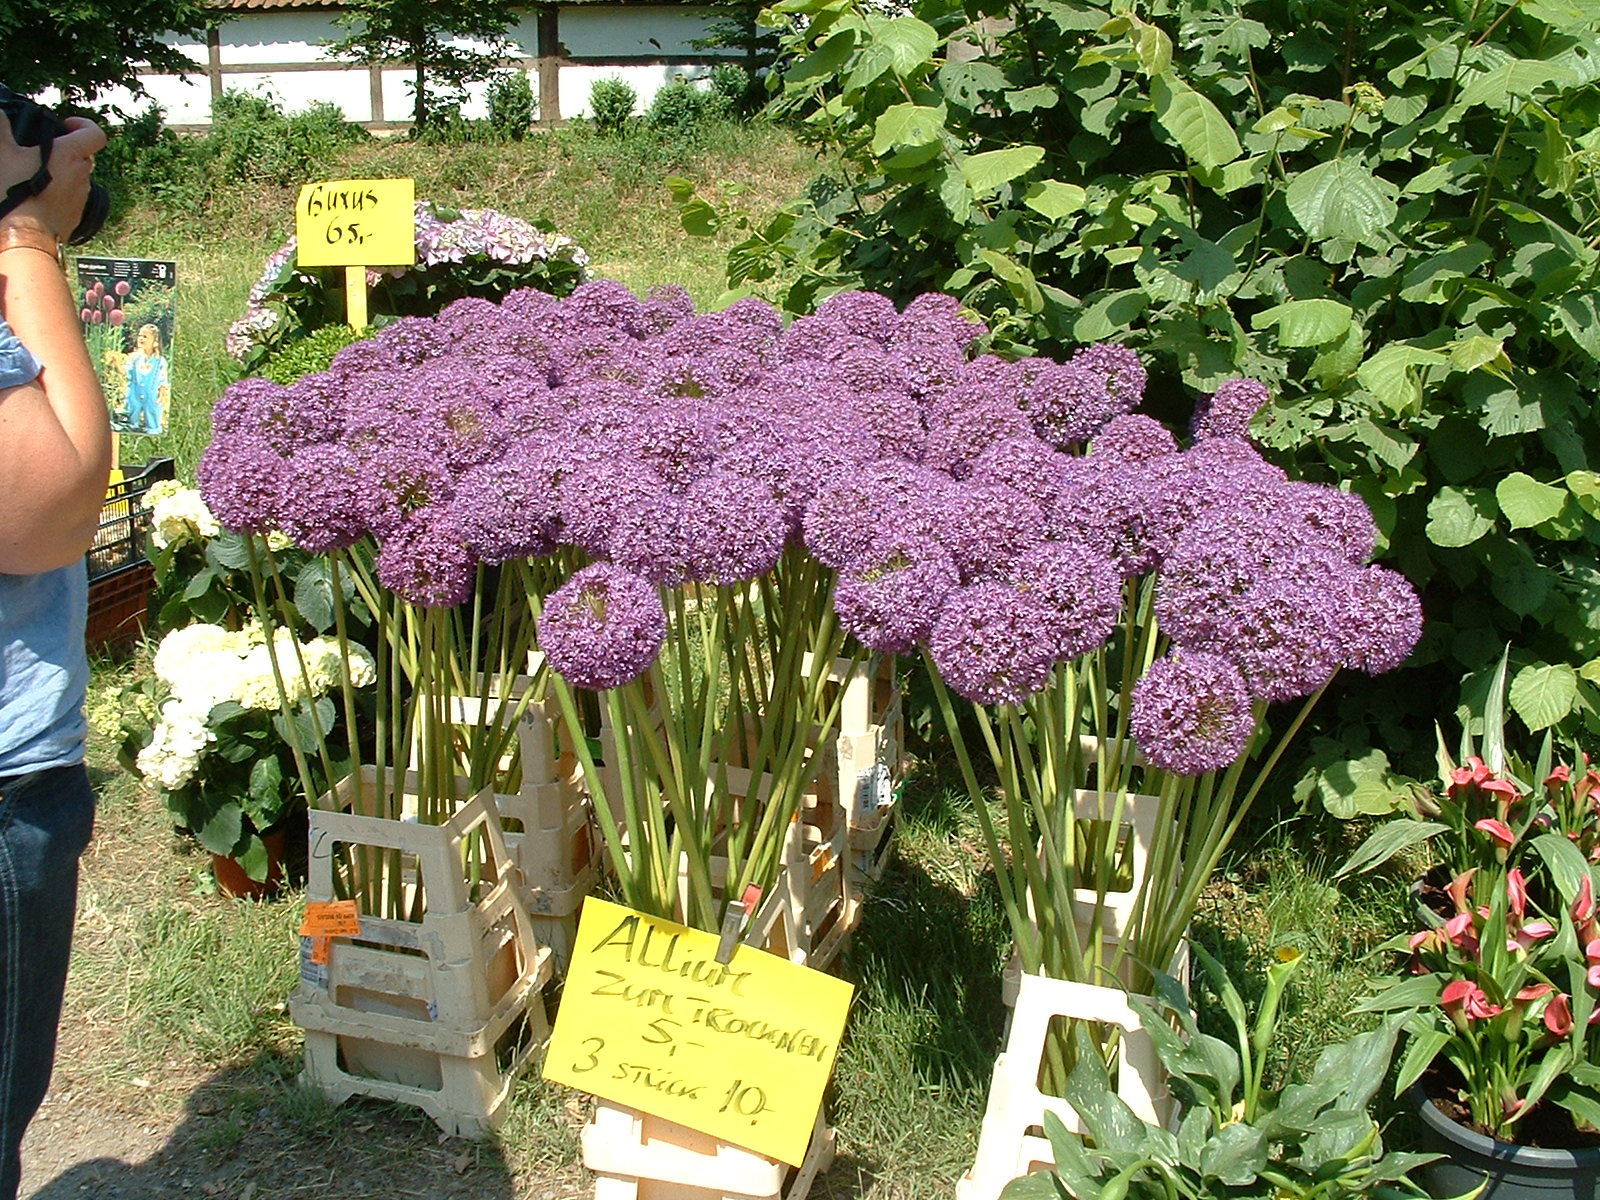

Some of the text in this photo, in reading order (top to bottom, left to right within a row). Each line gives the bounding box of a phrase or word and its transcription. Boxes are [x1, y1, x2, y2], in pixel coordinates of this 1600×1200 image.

[307, 185, 378, 217] Buxus
[326, 216, 373, 245] 65,-
[642, 1018, 705, 1057] 5,-
[572, 1037, 606, 1074] 3
